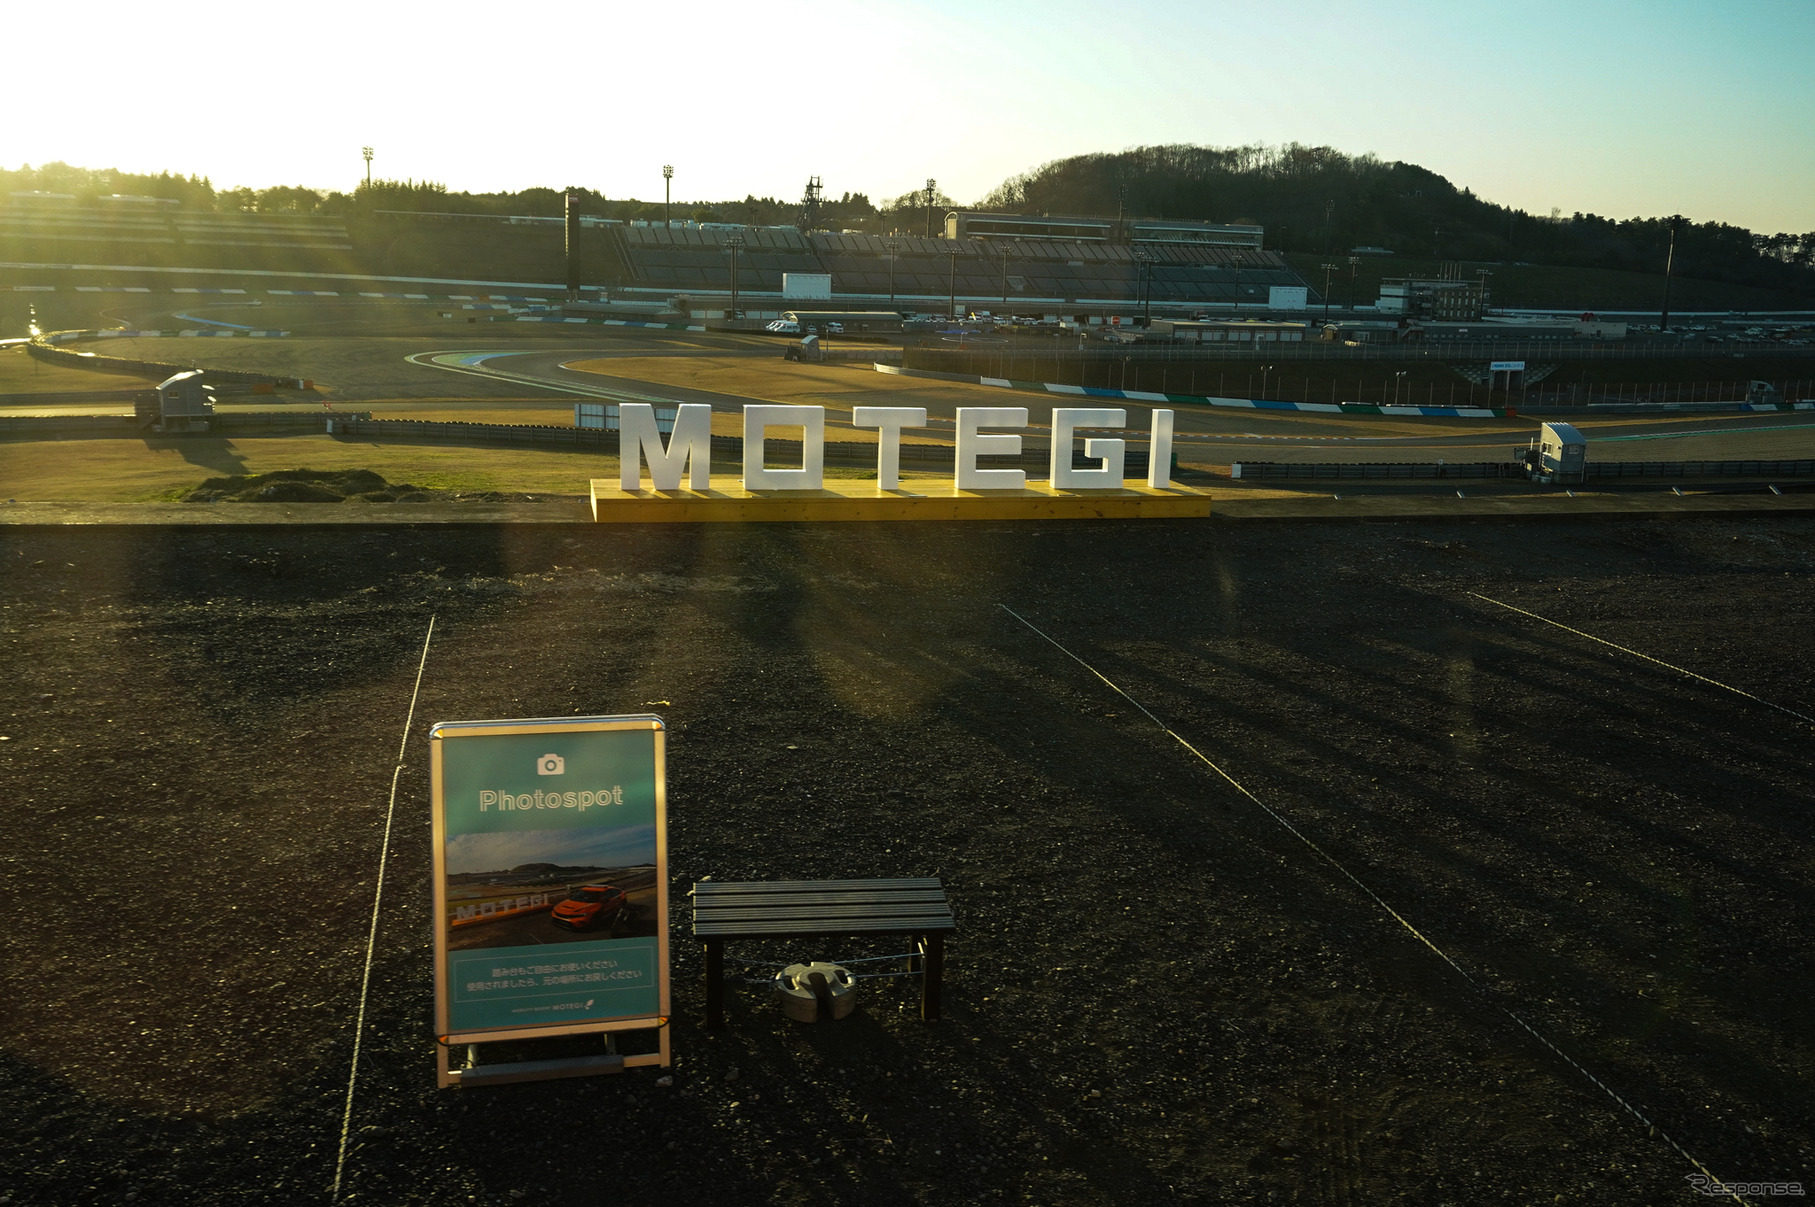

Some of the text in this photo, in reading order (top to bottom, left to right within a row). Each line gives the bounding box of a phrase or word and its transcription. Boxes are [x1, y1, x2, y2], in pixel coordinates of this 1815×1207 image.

[619, 403, 1174, 490] MOTEGI
[479, 785, 624, 812] Photospot
[456, 894, 549, 922] MOTEGI
